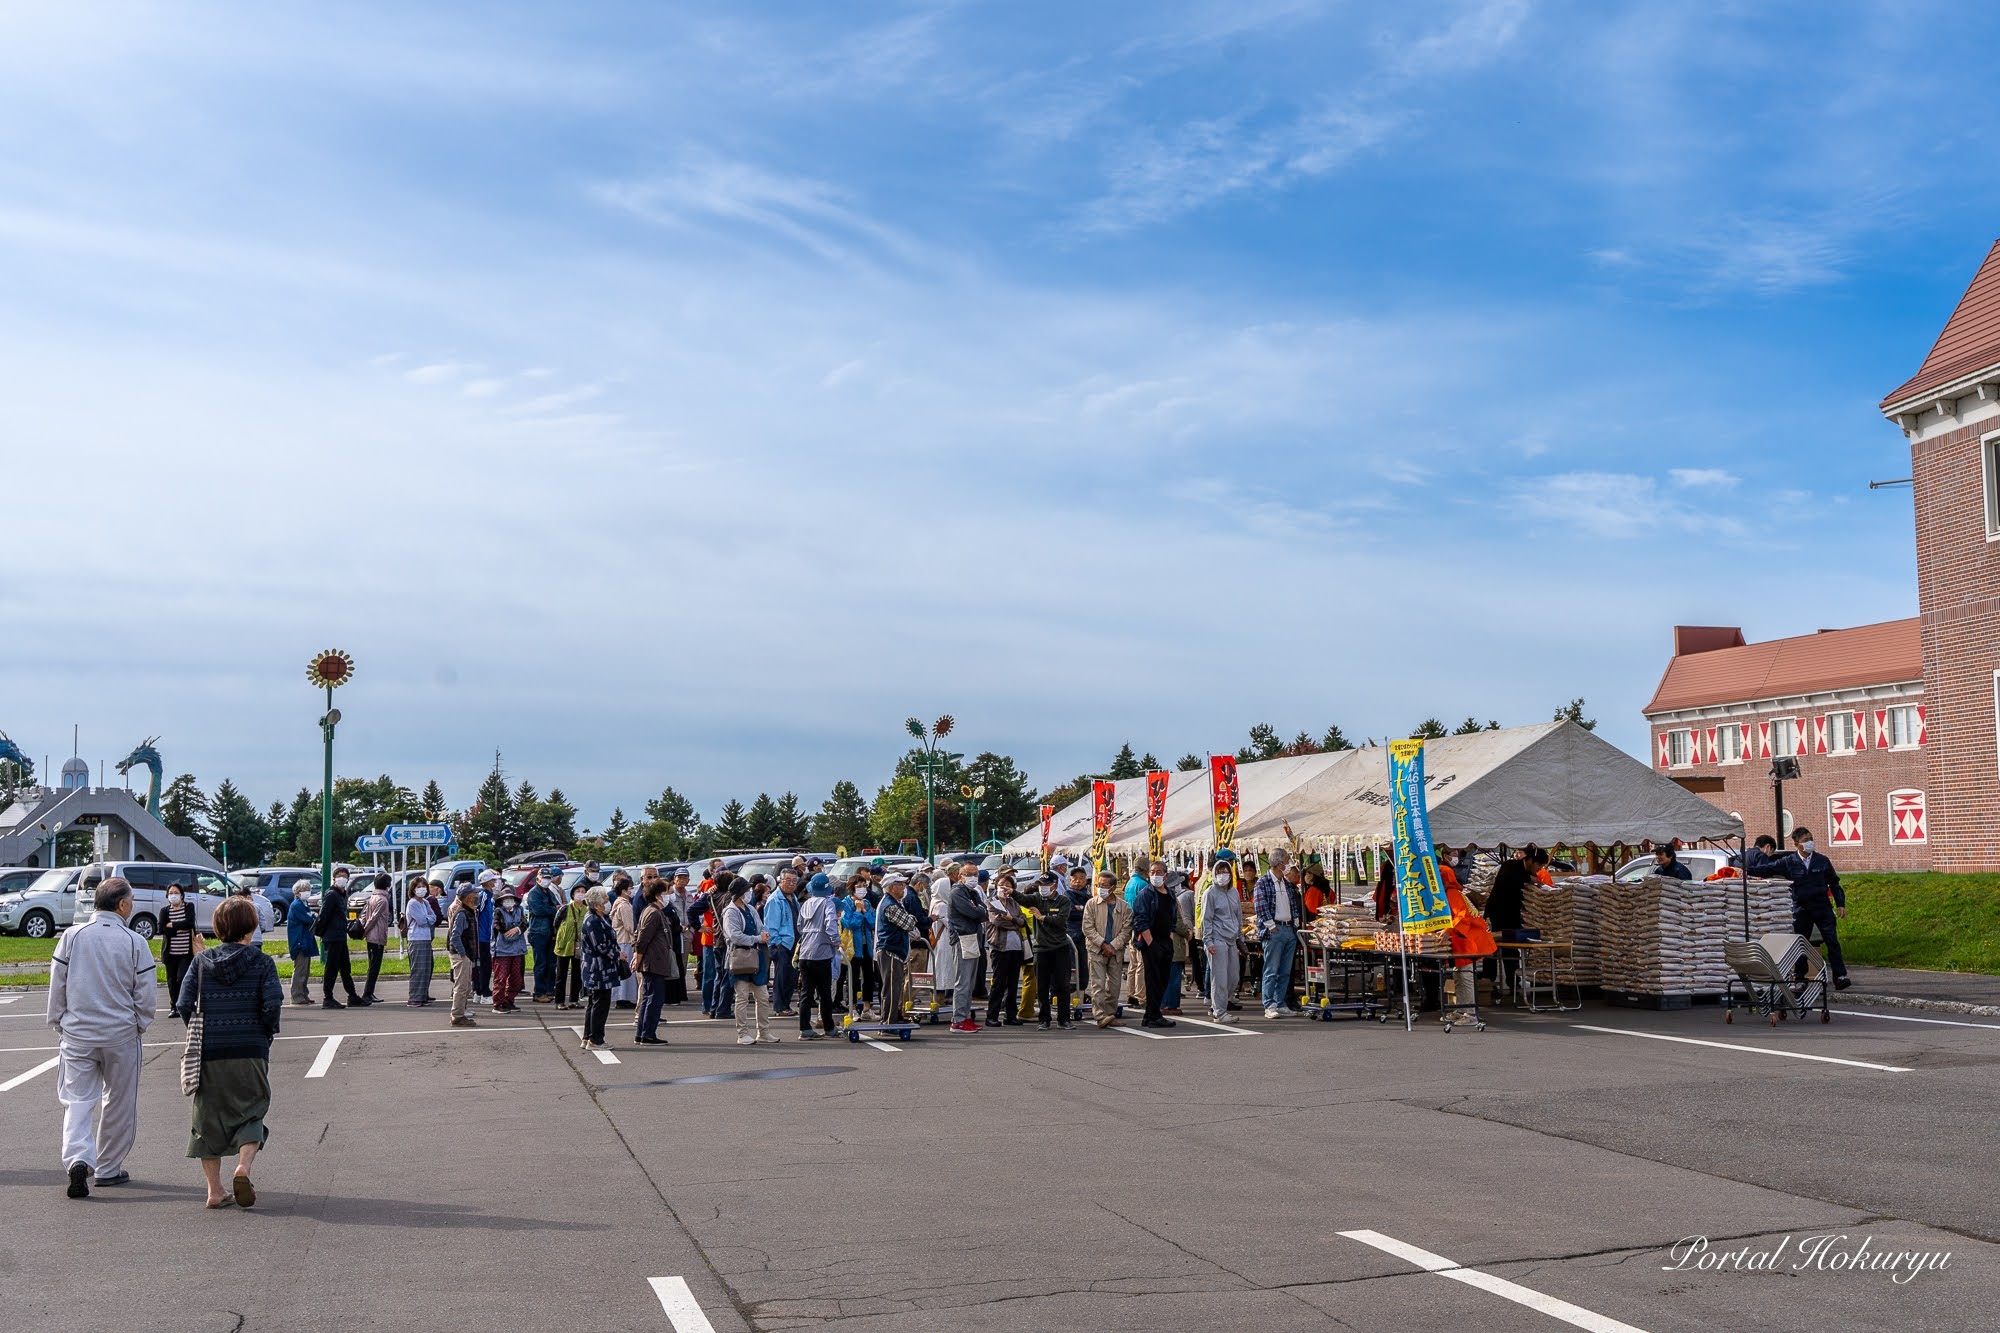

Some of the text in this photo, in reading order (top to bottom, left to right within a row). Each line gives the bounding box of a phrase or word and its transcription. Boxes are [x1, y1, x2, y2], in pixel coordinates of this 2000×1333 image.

[403, 830, 444, 840] 第二駐車場
[1393, 769, 1430, 919] 大賞受賞
[1406, 761, 1429, 853] 第46回日本農業賞
